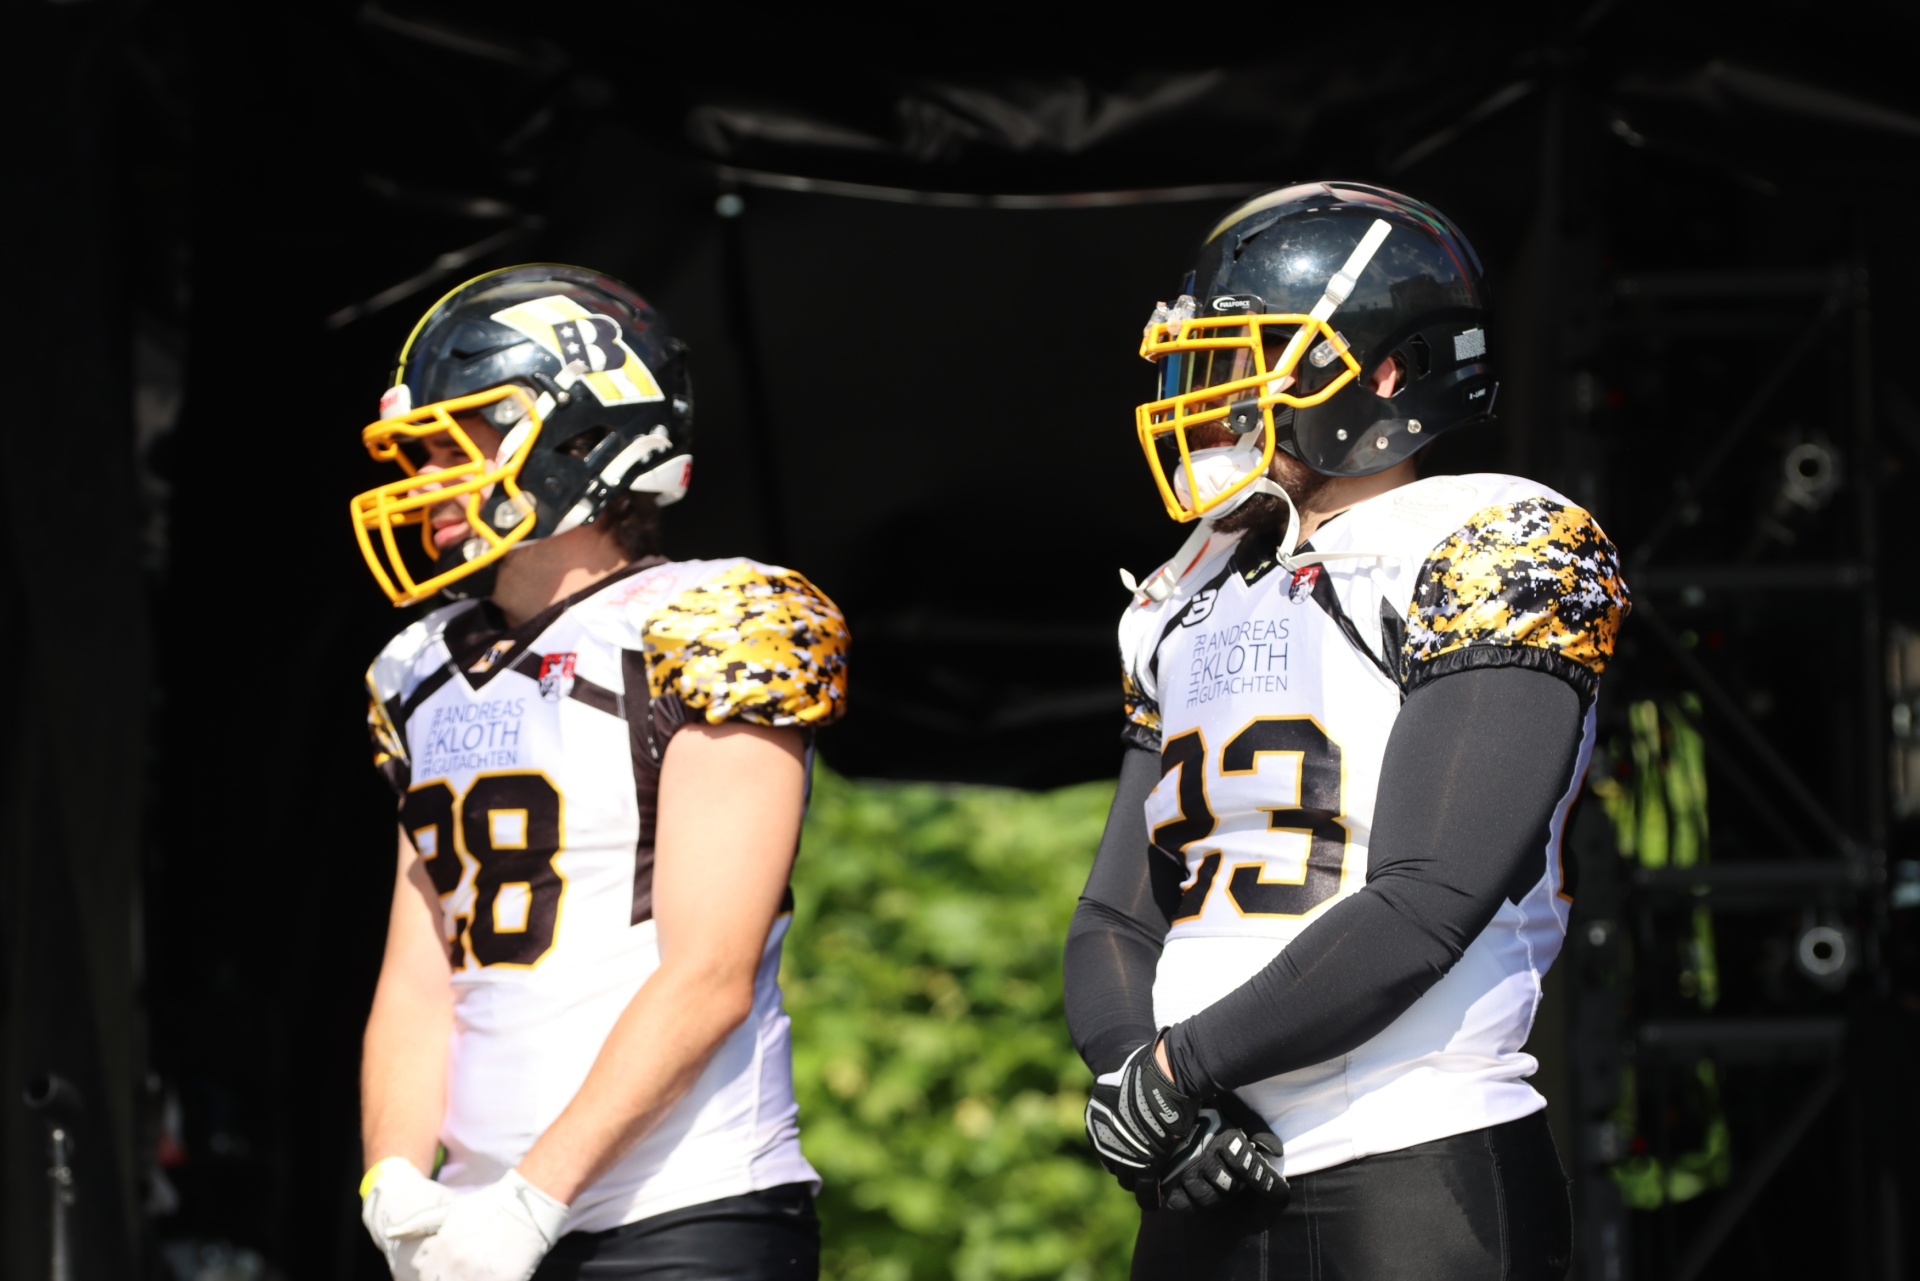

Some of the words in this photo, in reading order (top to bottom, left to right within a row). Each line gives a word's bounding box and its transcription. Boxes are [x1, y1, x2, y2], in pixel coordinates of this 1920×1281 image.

[1207, 618, 1290, 653] ANDREAS
[1186, 633, 1207, 709] RECHTE
[1202, 642, 1289, 684] KLOTH
[1199, 675, 1288, 704] GUTACHTEN
[442, 697, 526, 724] ANDREAS
[435, 719, 522, 755] KLOTH
[431, 749, 518, 775] GUTACHTEN
[1152, 714, 1351, 925] 23
